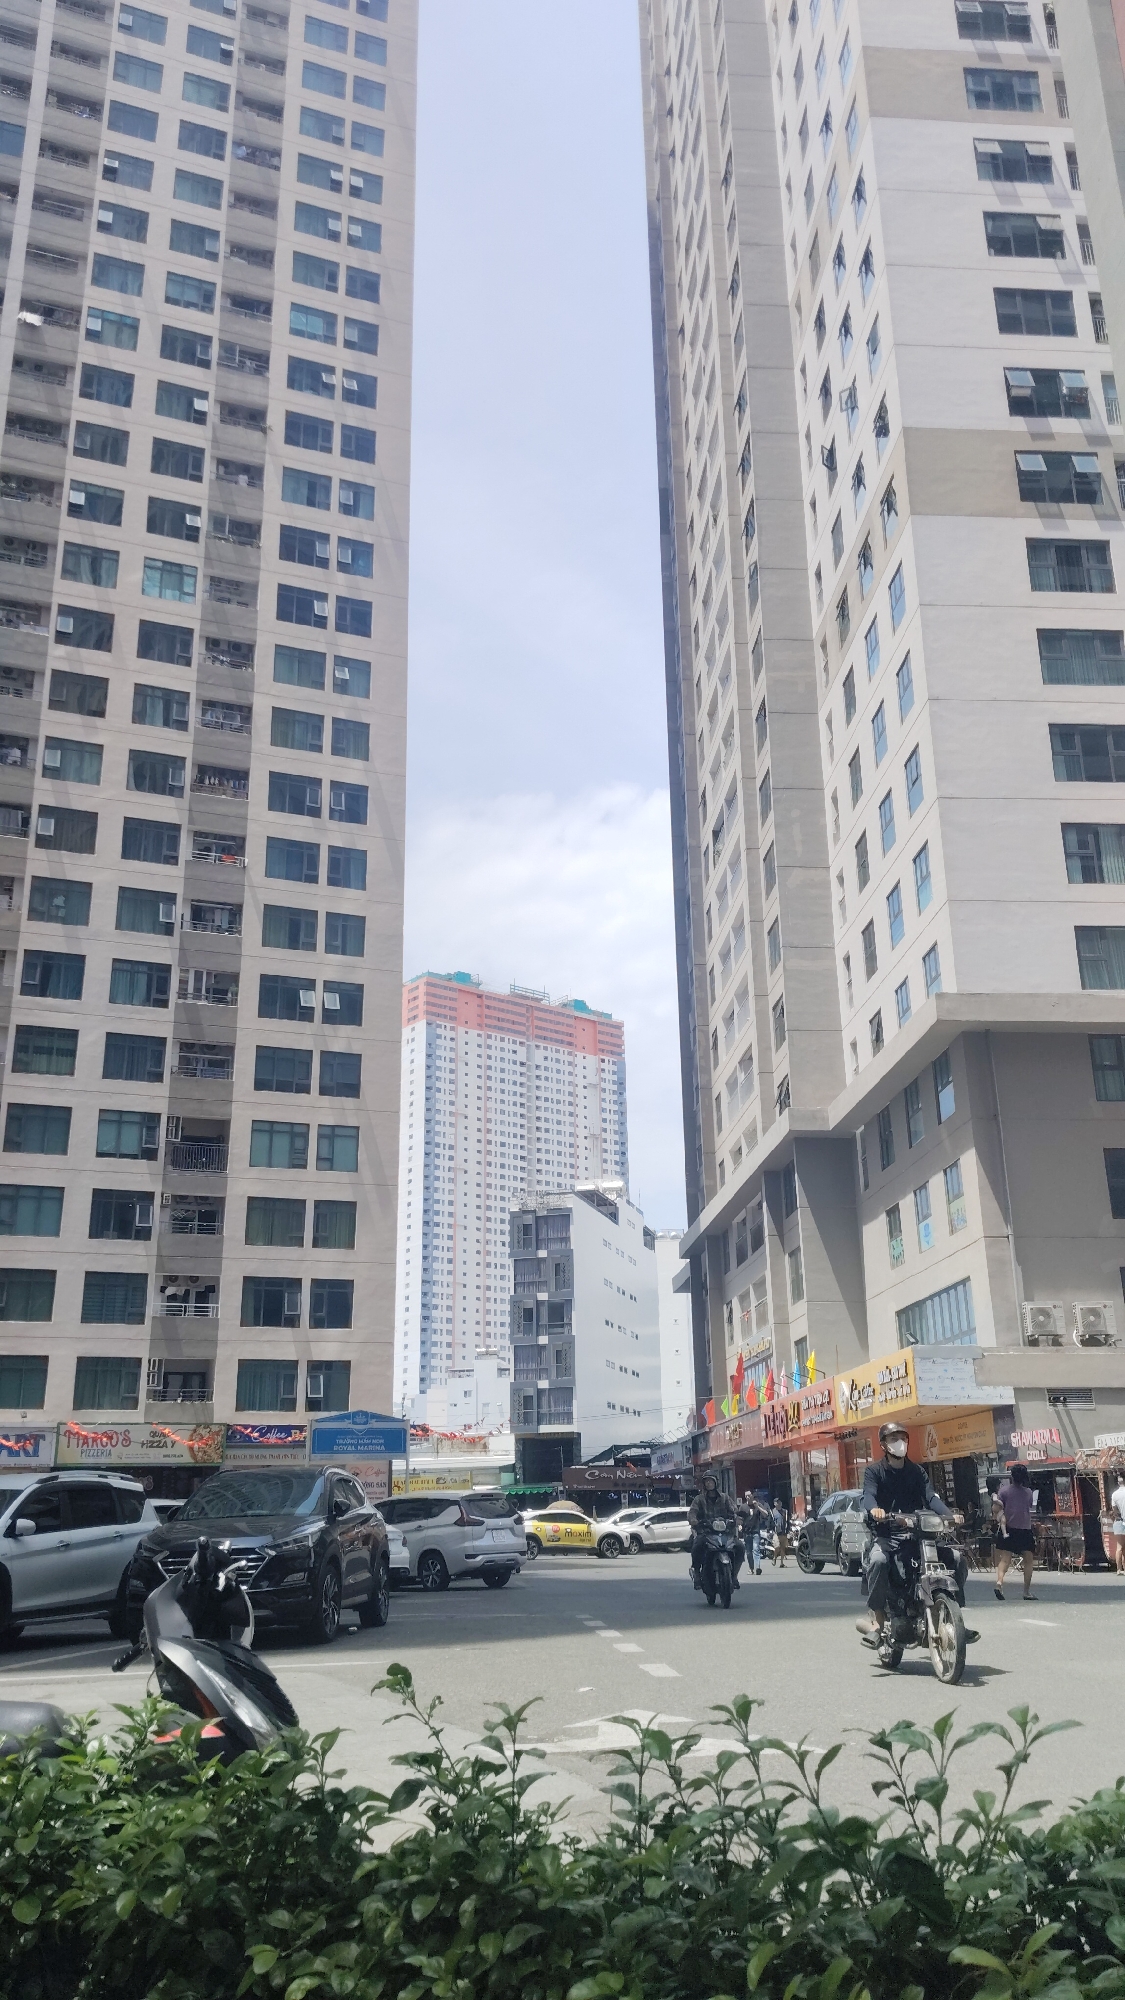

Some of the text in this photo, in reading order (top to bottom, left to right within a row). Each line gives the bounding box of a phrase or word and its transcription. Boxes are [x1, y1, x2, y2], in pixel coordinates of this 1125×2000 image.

[64, 1428, 132, 1448] MARCO'S
[252, 1425, 288, 1442] Coffee
[80, 1449, 112, 1458] PIZZERIA
